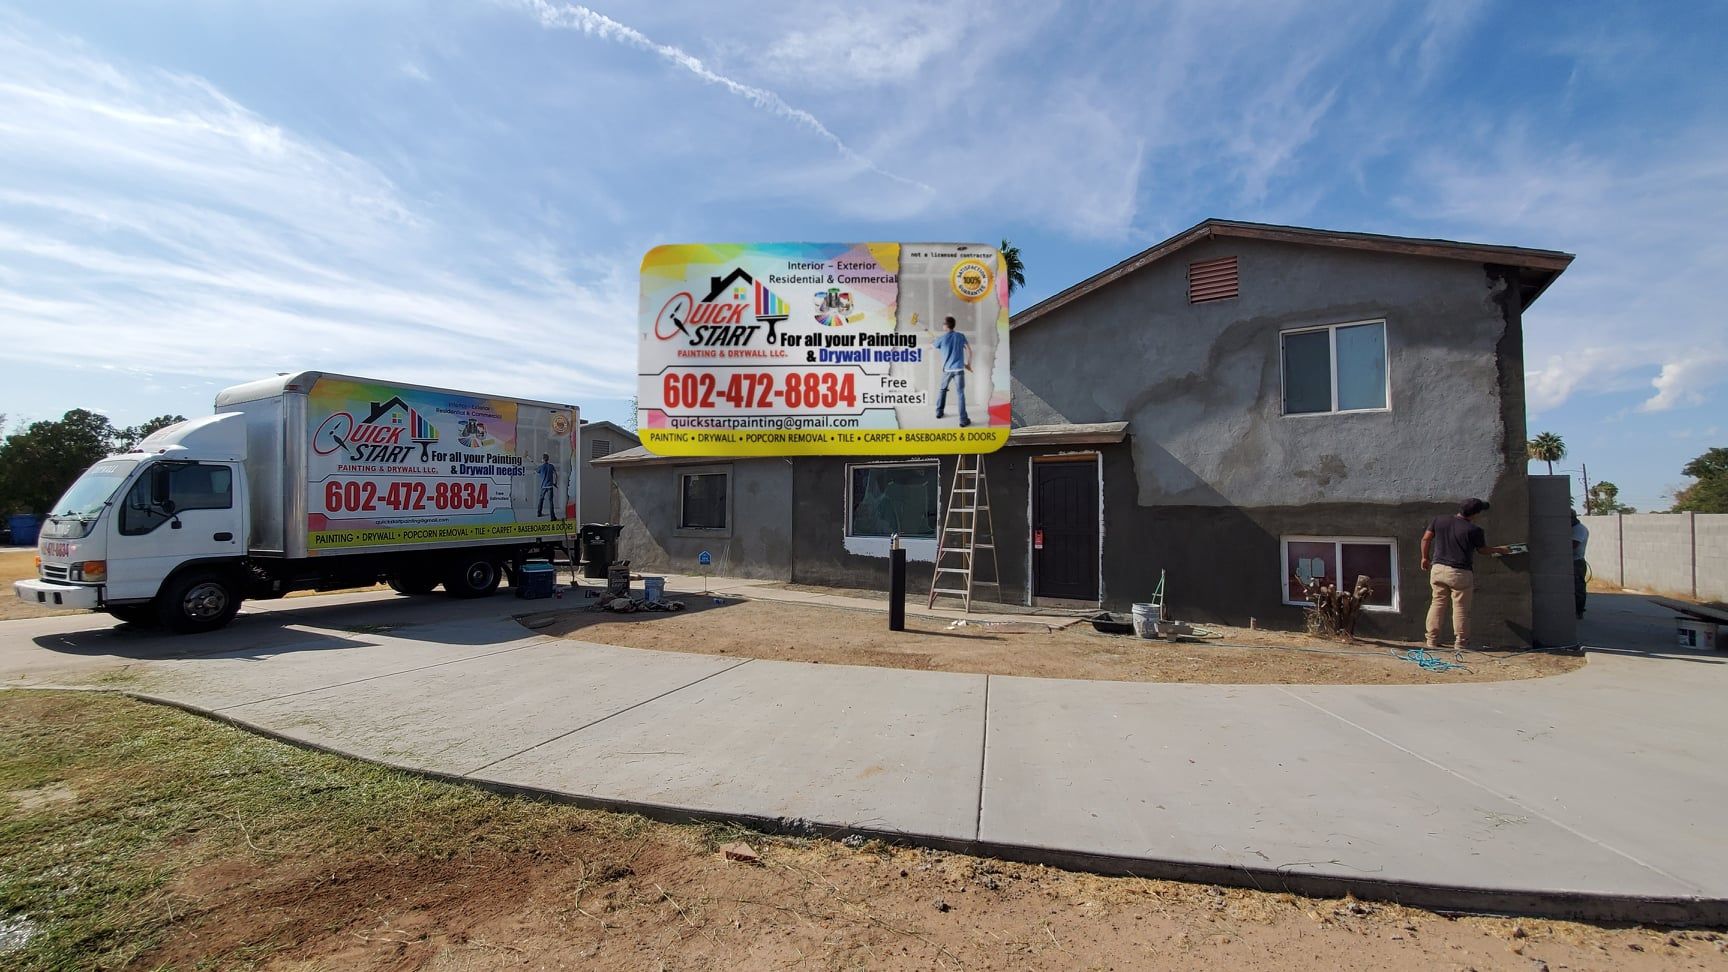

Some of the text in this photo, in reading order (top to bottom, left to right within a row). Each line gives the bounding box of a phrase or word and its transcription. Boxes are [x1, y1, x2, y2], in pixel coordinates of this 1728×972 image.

[350, 444, 416, 463] START
[432, 450, 522, 466] For all your Painting
[451, 464, 525, 476] & Drywall needs!
[325, 480, 489, 512] 602-472-8834
[315, 534, 353, 544] PAINTING
[362, 530, 395, 541] DRYWALL
[404, 530, 437, 539] POPCORN
[439, 528, 468, 537] REMOVAL
[475, 527, 485, 535] TILE
[492, 526, 512, 534] CARPET
[518, 524, 550, 533] BASEBOARDS
